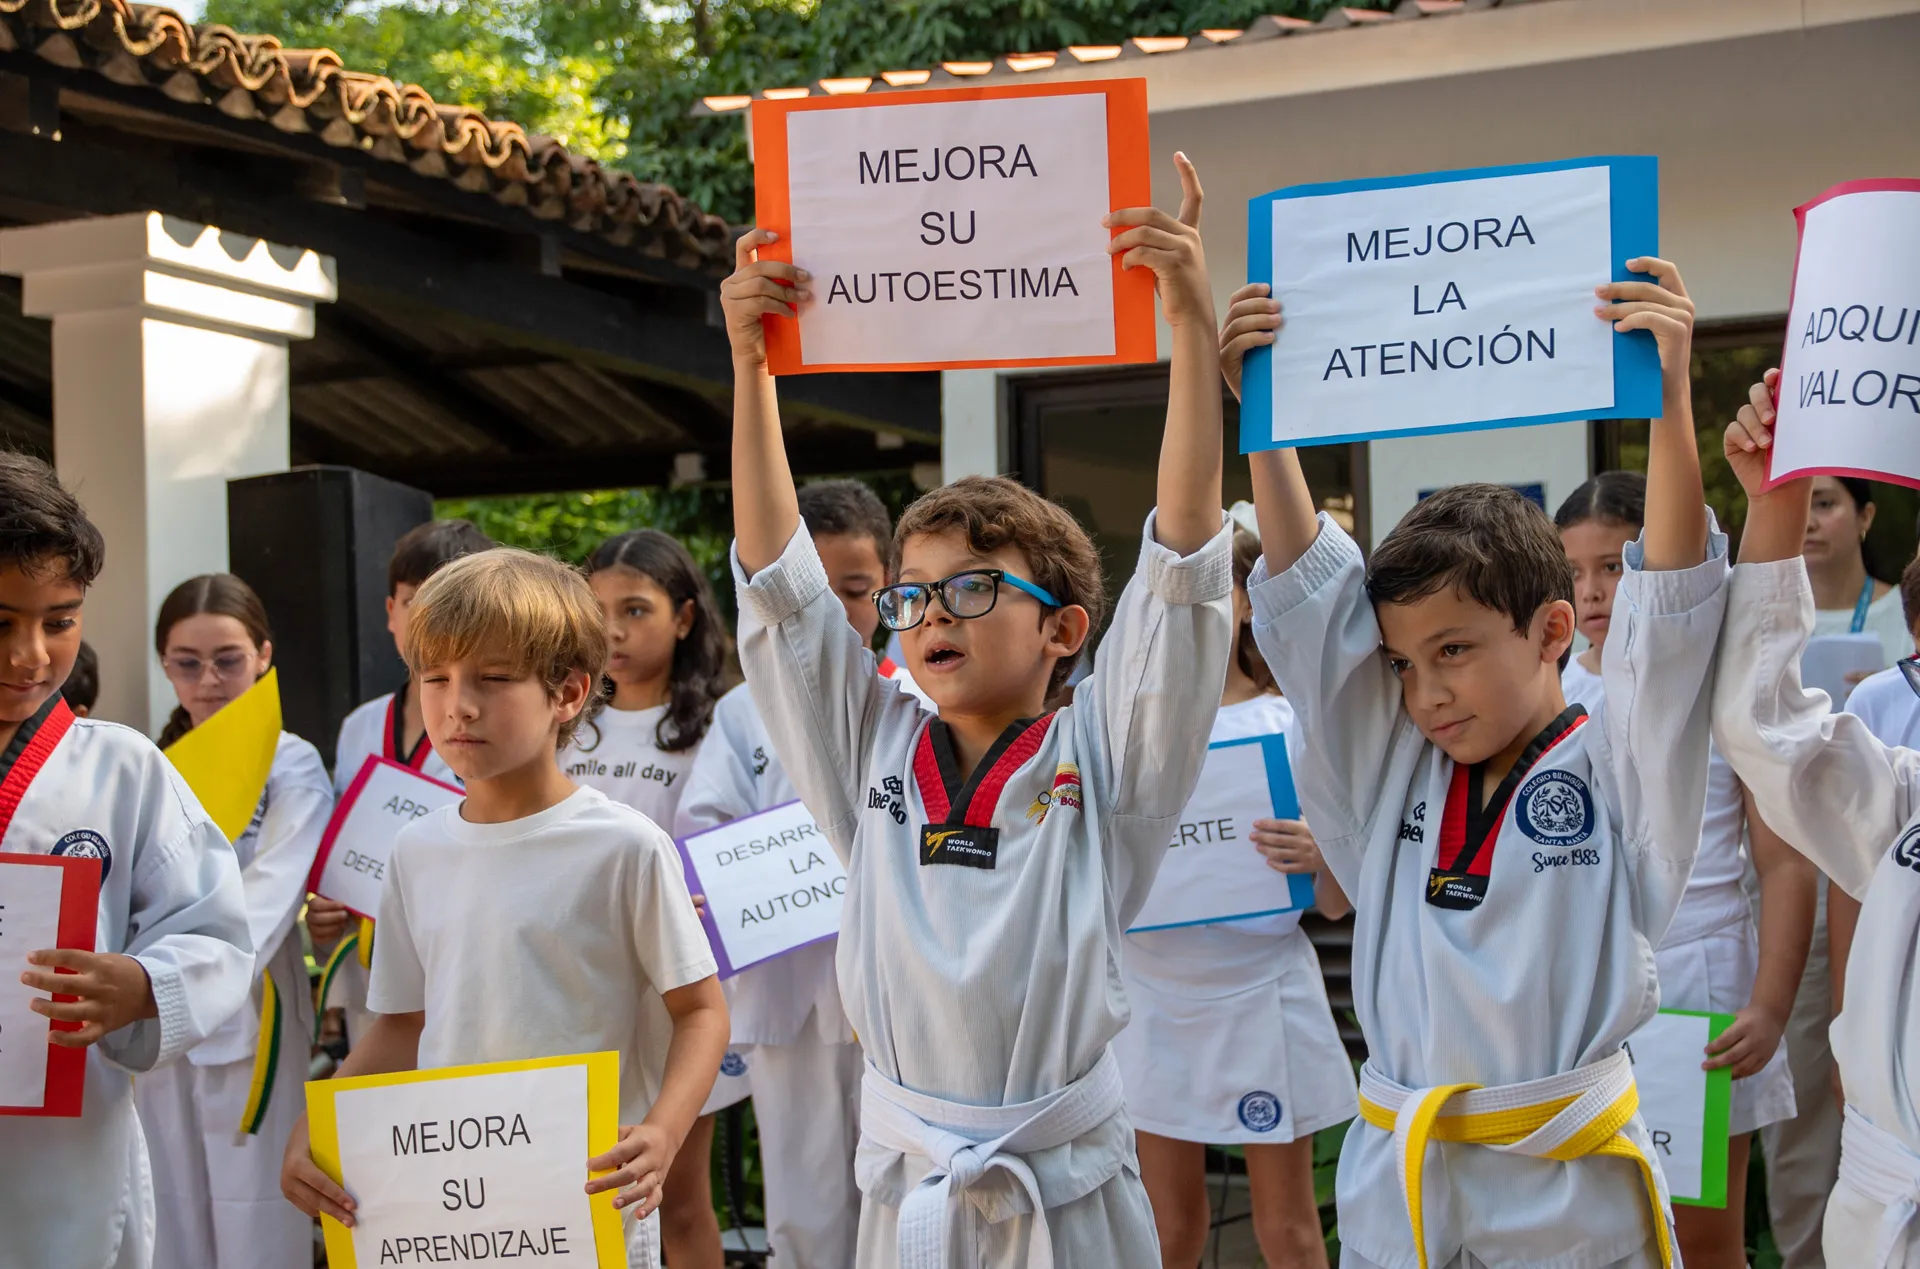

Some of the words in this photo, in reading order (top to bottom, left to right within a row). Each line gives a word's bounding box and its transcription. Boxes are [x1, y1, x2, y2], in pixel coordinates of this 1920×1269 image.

[858, 143, 1038, 185] MEJORA
[920, 209, 976, 246] SU
[1346, 214, 1536, 263] MEJORA
[827, 266, 1079, 305] AUTOESTIMA
[1413, 281, 1467, 316] LA
[1322, 324, 1556, 381] ATENCIÓN
[1799, 369, 1920, 415] VALOR
[613, 761, 637, 778] all
[641, 763, 678, 788] day
[1522, 773, 1551, 797] COLEGIO
[1552, 772, 1585, 791] BILINGÜE
[715, 823, 823, 867] DESARR
[946, 845, 992, 857] TAEKWONDO
[947, 838, 974, 848] WORLD
[1533, 834, 1565, 846] SANTA
[1566, 831, 1589, 846] MARTA
[789, 851, 826, 875] LA
[1532, 852, 1570, 873] Since
[1571, 849, 1600, 866] 1983
[1447, 883, 1472, 893] WORLD
[392, 1113, 531, 1156] MEJORA
[442, 1176, 485, 1211] SU
[380, 1226, 570, 1265] APRENDIZAJE
